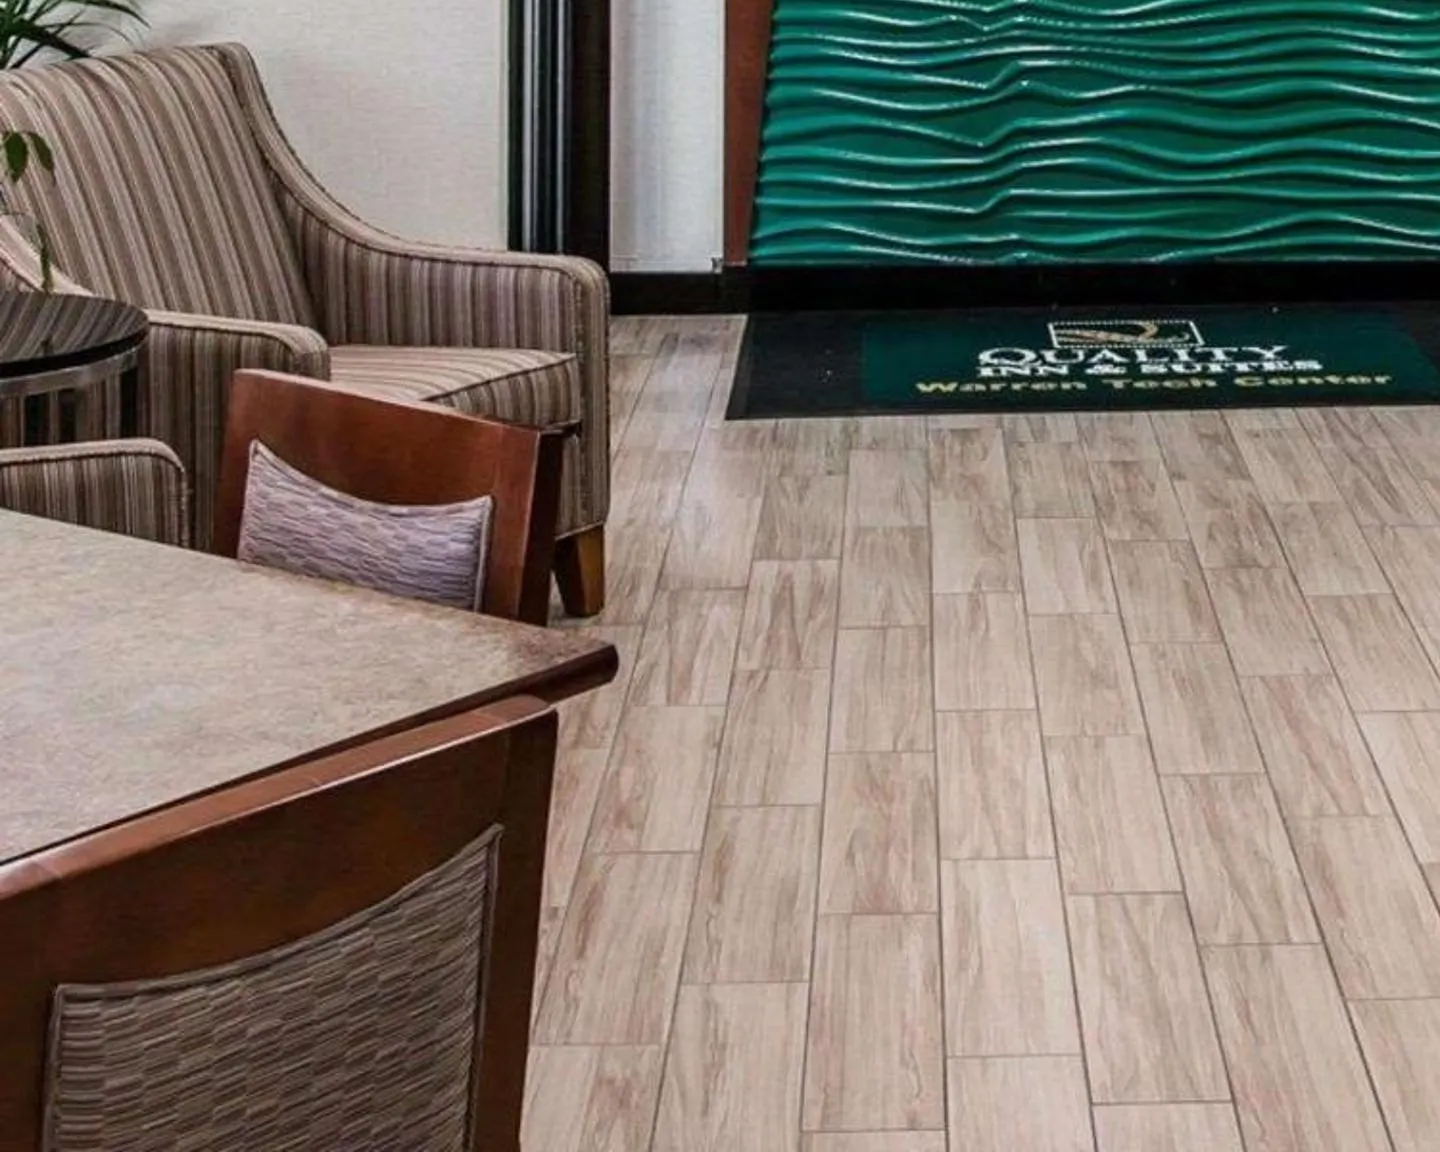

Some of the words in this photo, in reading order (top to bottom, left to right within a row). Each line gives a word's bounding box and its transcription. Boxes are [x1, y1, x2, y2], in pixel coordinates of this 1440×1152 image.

[977, 346, 1287, 365] QUALITY
[977, 364, 1069, 377] INN
[1084, 363, 1127, 375] &
[1140, 360, 1323, 374] SUITES
[916, 380, 1087, 393] Warren
[1102, 378, 1217, 390] Tech
[1233, 375, 1392, 388] Center
